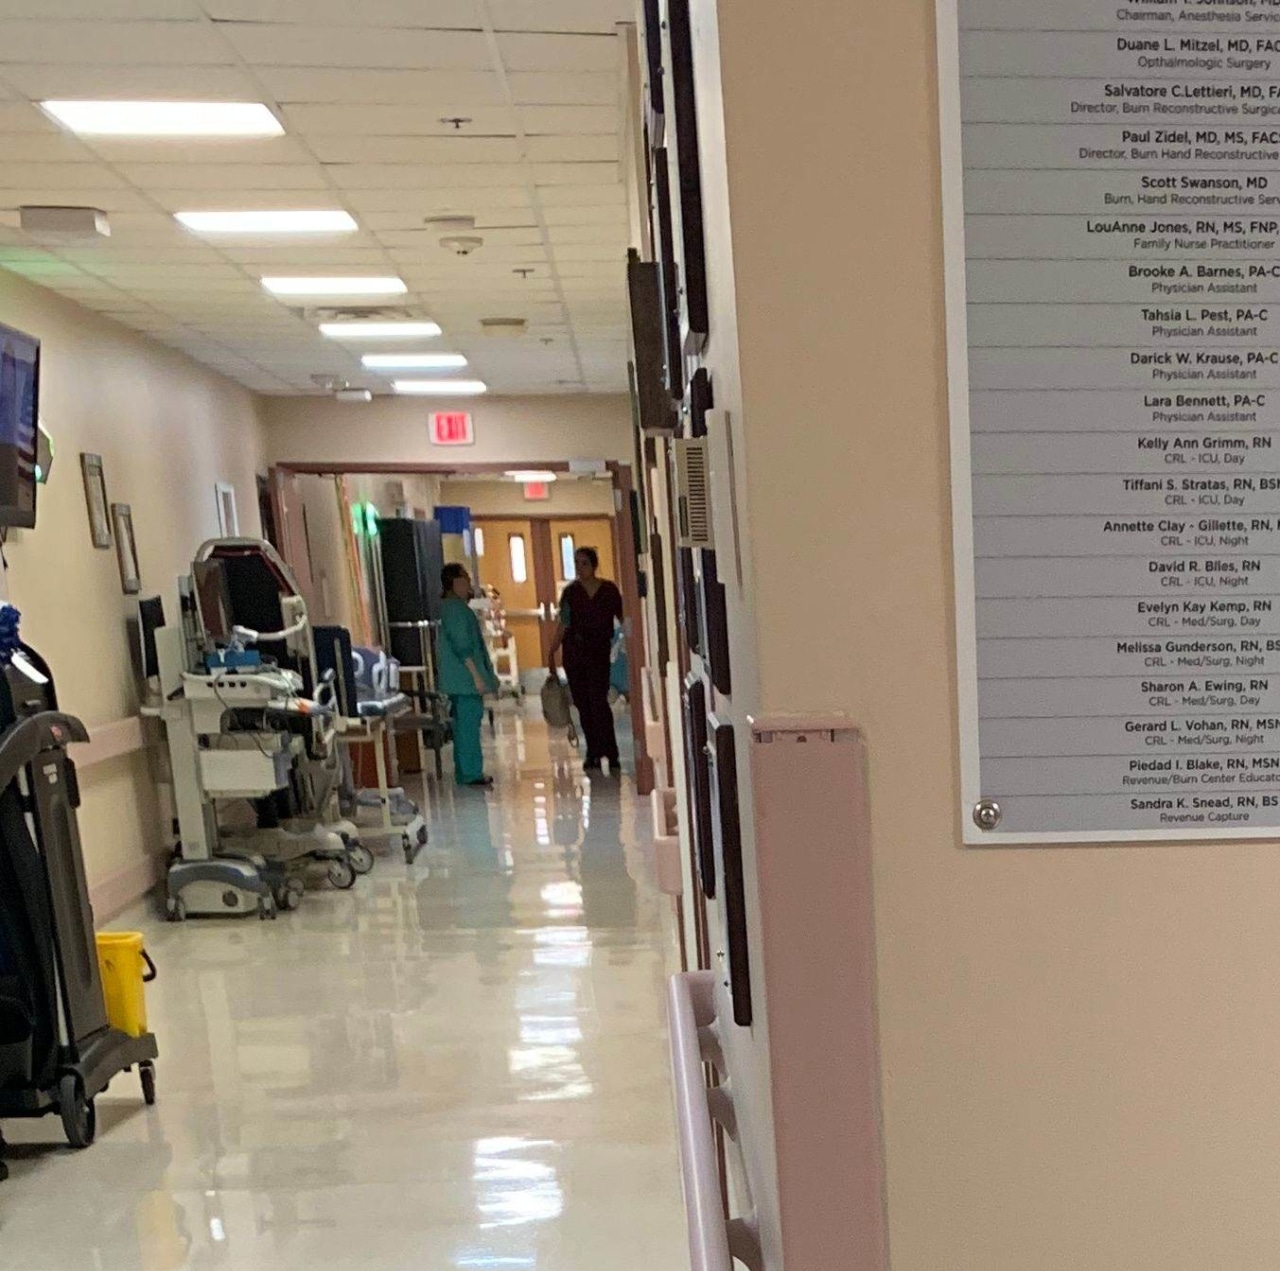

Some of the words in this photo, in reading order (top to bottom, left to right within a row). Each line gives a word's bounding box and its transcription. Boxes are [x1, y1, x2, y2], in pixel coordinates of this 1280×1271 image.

[1178, 10, 1242, 22] Anesthesia
[1117, 38, 1160, 51] Duane
[1105, 84, 1167, 97] Salvatore
[1122, 102, 1150, 113] Burn
[1152, 102, 1239, 115] Reconstructive
[1122, 131, 1150, 143] Paul
[1141, 176, 1177, 188] Scott
[1246, 177, 1268, 189] MD
[1087, 221, 1146, 233] LouAnne
[1129, 265, 1175, 277] Brooke
[1179, 266, 1192, 277] A.
[1249, 266, 1280, 277] PA-C
[1236, 309, 1268, 321] PA-C
[1144, 396, 1172, 407] Lara
[1234, 395, 1265, 406] PA-C
[1138, 437, 1169, 451] Kelly
[1173, 438, 1199, 449] Ann
[1252, 437, 1271, 448] RN
[1117, 642, 1162, 653] Melissa
[1141, 682, 1184, 692] Sharon
[1188, 681, 1201, 691] A.
[1250, 680, 1268, 690] RN
[1123, 774, 1198, 785] Revenue/Burn
[1200, 773, 1236, 783] Center
[1131, 798, 1173, 809] Sandra
[1177, 798, 1189, 808] K.
[1262, 796, 1278, 806] BS
